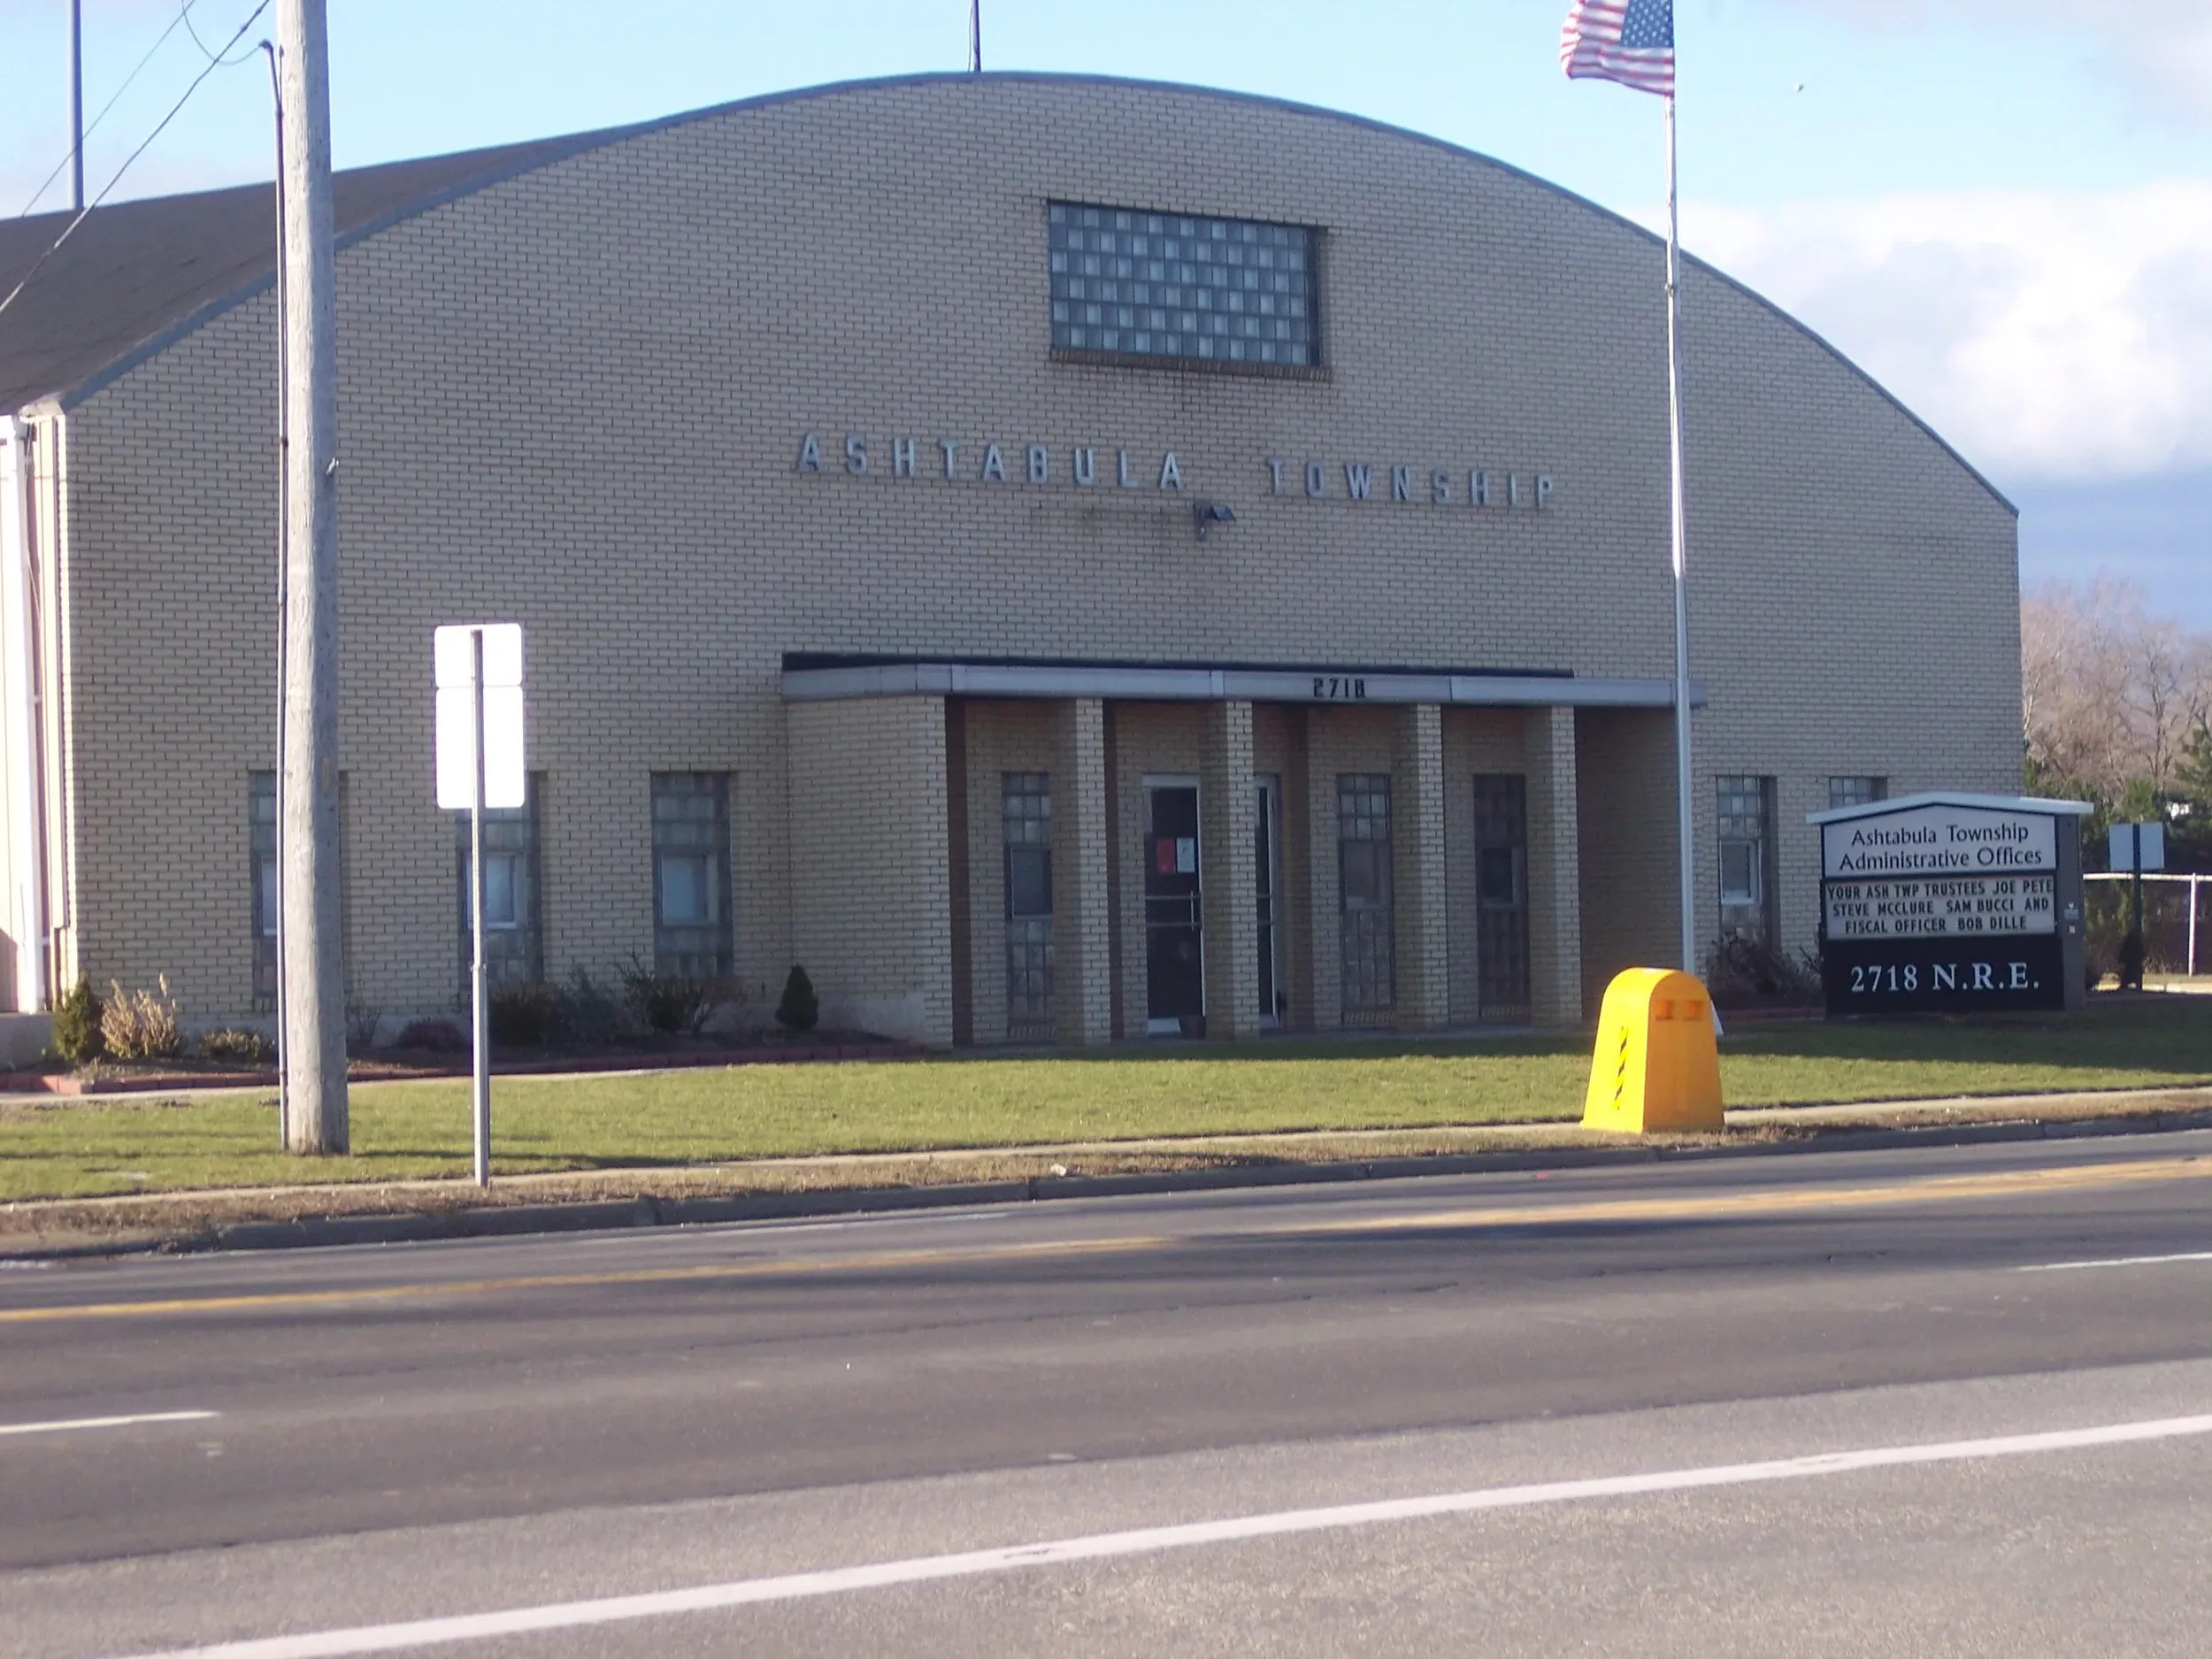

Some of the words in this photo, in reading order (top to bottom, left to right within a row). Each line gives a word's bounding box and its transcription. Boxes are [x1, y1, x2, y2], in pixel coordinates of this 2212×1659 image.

[798, 432, 1183, 491] ASHTABULA
[1266, 457, 1554, 510] TOWNSHIP
[1313, 677, 1366, 698] 2718
[1851, 826, 1937, 847] Ashtabula
[1947, 822, 2029, 843] Township
[1839, 850, 1970, 871] Administrative
[1977, 846, 2042, 866] Offices
[1827, 885, 1861, 900] YOUR
[1866, 884, 1889, 898] ASH
[1894, 883, 1919, 897] TWP
[1924, 880, 1985, 897] TRUSTEES
[1993, 880, 2016, 895] JOE
[2023, 879, 2053, 893] PETE
[1832, 902, 1869, 917] STEVE
[1878, 901, 1934, 916] MCCLURE
[1946, 899, 1971, 914] SAM
[1978, 898, 2014, 912] BUCCI
[2024, 897, 2049, 911] AND
[1845, 920, 1888, 934] FISCAL
[1894, 918, 1946, 933] OFFICER
[1958, 917, 1983, 930] BOB
[1990, 916, 2026, 929] DILLE
[1851, 964, 1917, 992] 2718
[1932, 962, 2039, 990] N.R.E.
